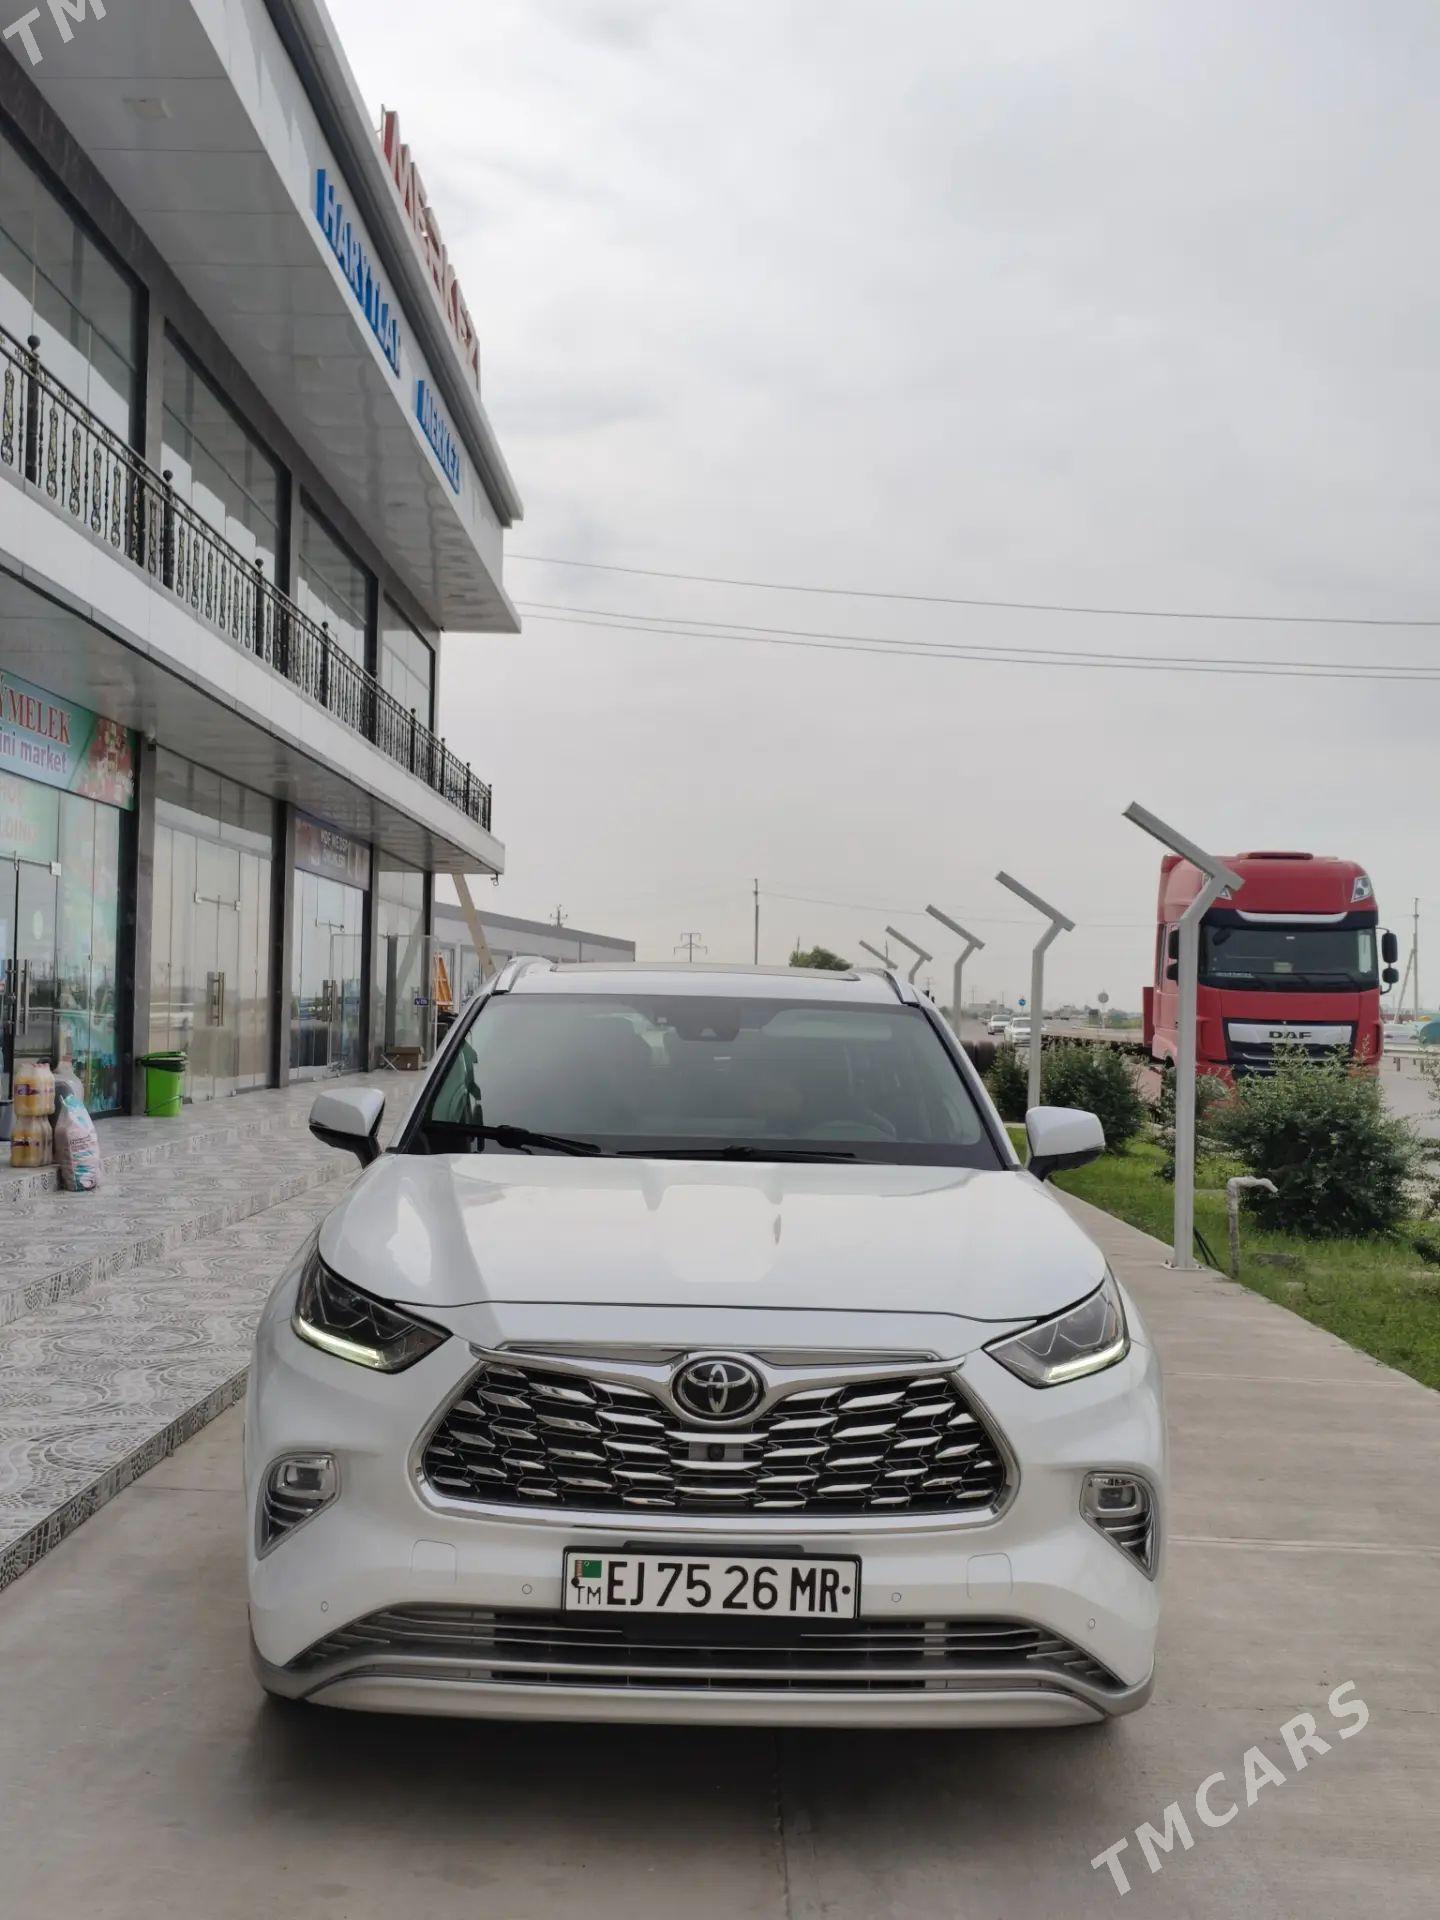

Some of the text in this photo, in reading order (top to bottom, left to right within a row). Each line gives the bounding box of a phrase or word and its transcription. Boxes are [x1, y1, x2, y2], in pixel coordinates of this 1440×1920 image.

[20, 740, 67, 775] market
[1268, 1030, 1313, 1040] DAF
[575, 1585, 602, 1605] TM
[606, 1560, 841, 1613] EJ 75 26 MR
